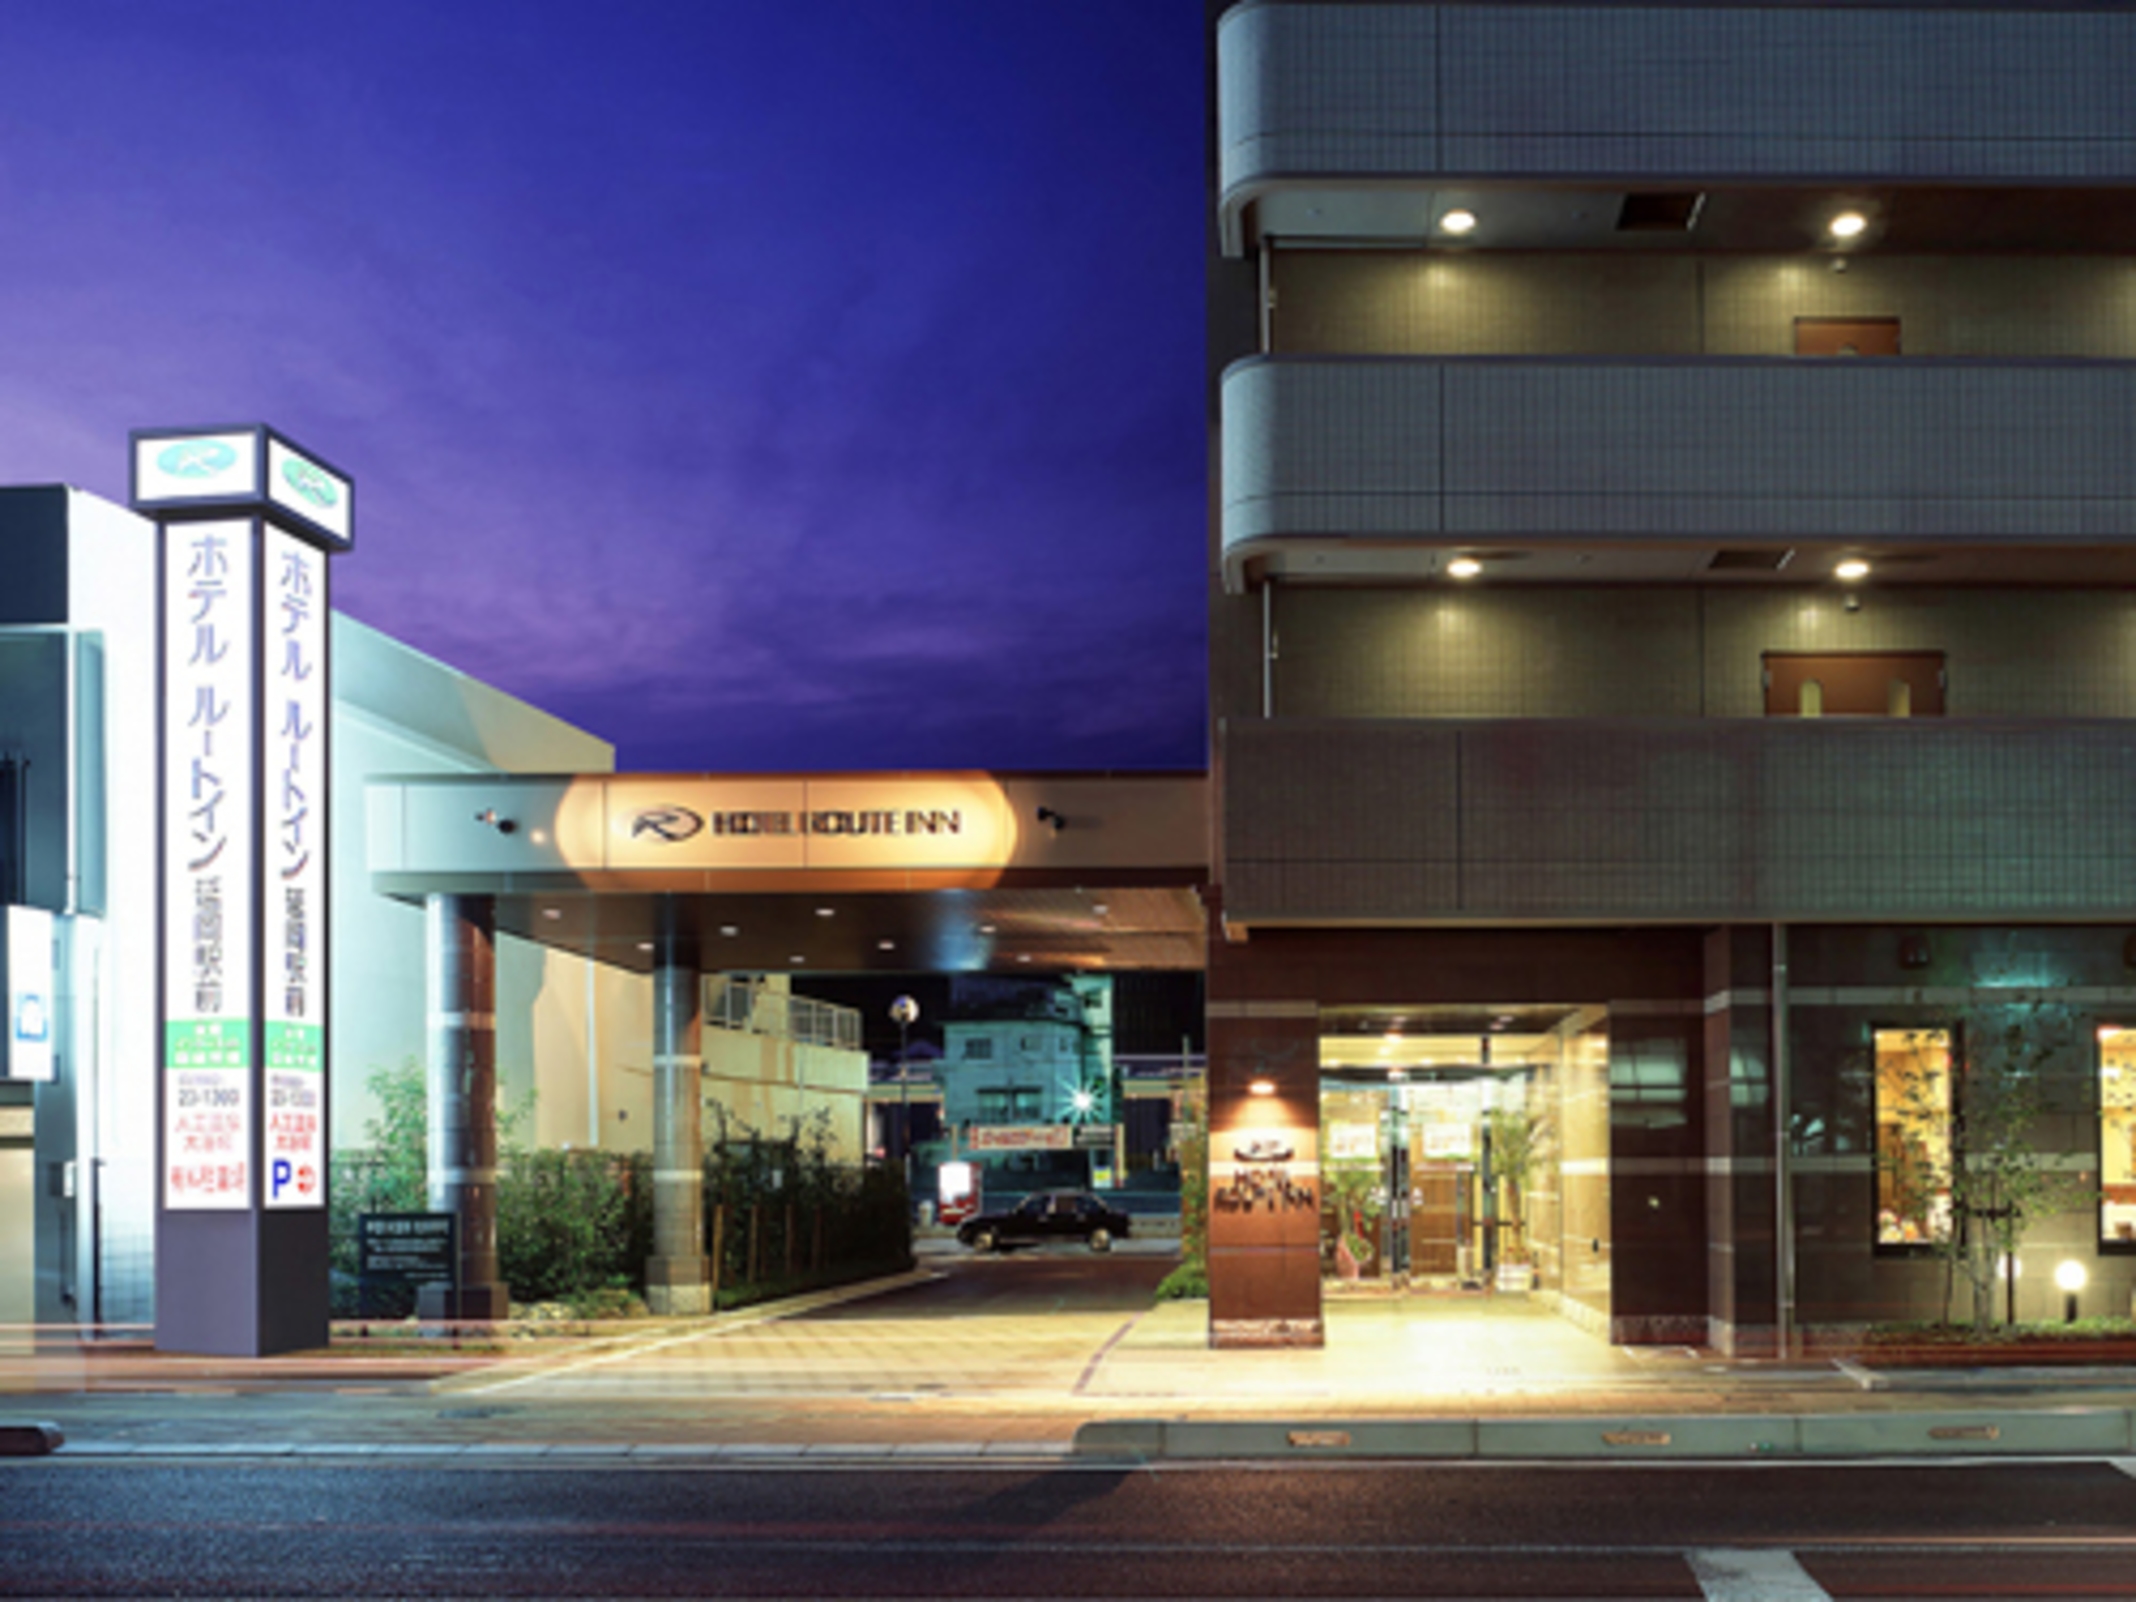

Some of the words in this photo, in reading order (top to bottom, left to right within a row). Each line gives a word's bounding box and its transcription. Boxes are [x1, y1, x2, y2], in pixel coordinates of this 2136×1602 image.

[188, 534, 229, 666] ホテル
[281, 551, 312, 681] ホテル
[713, 811, 792, 835] HOTEL
[800, 811, 898, 835] ROUTE
[905, 810, 960, 834] INN
[272, 1157, 292, 1200] P
